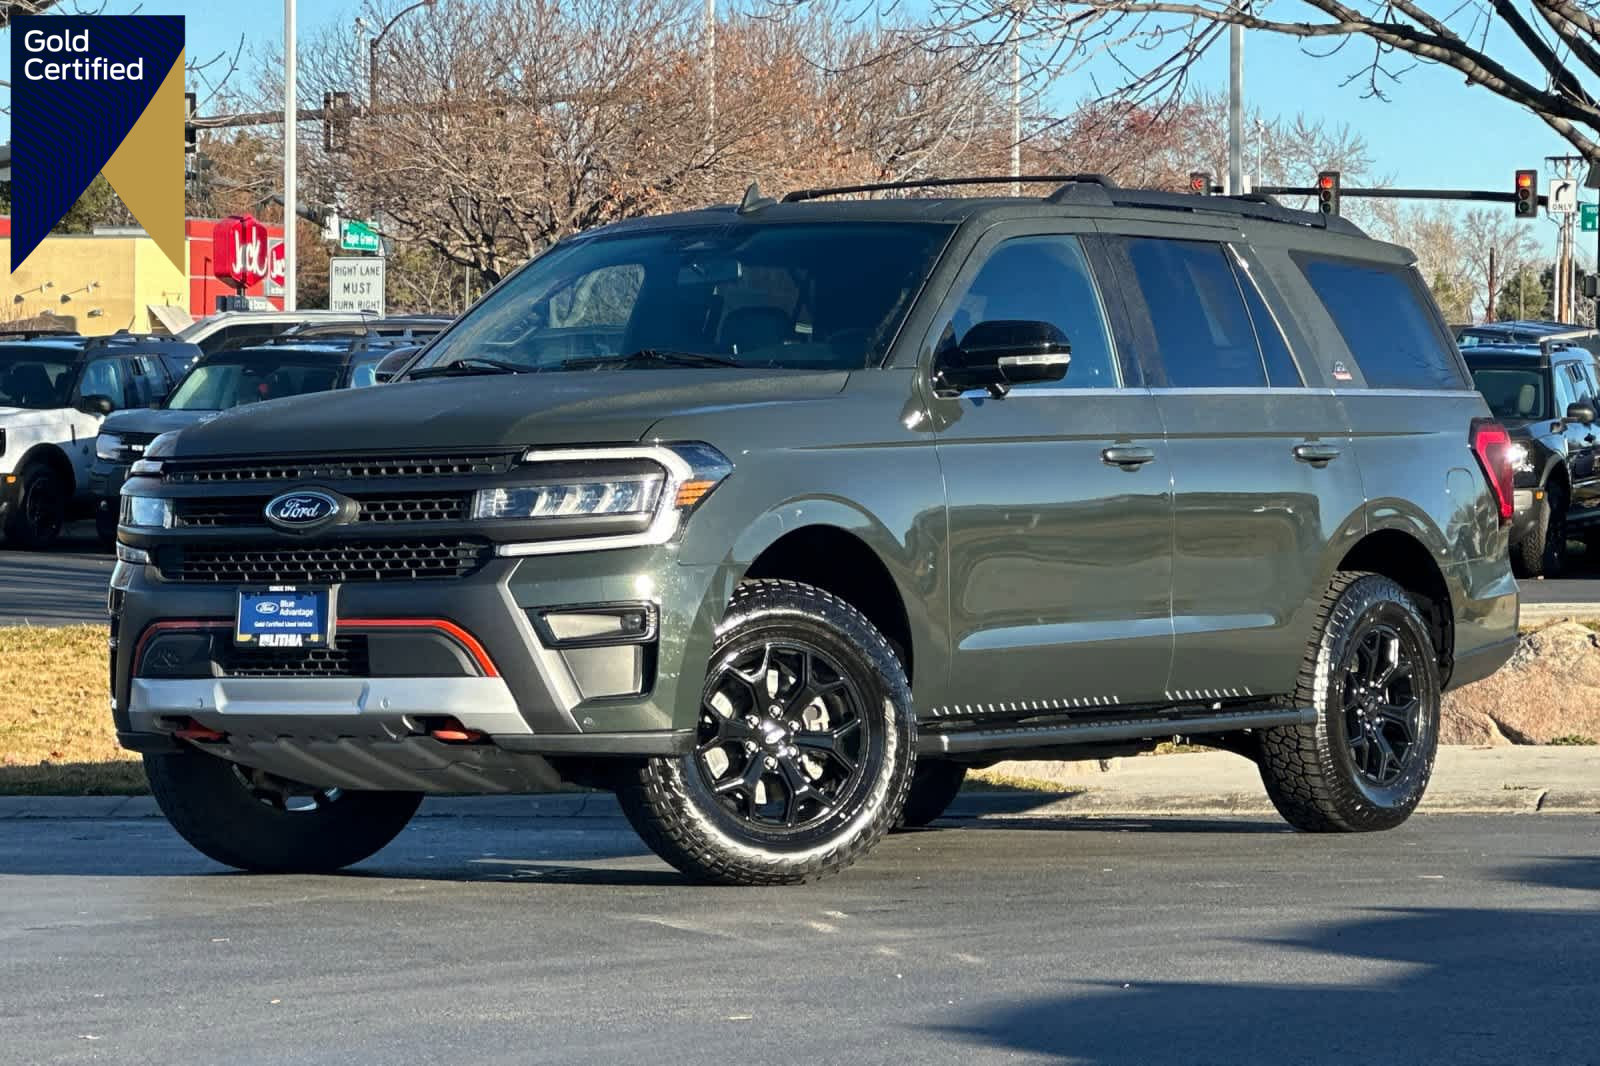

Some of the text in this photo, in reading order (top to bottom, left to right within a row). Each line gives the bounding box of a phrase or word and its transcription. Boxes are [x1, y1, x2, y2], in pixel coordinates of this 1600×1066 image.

[232, 226, 268, 276] Jack
[334, 266, 380, 276] RIGHT LANE
[343, 282, 371, 294] MUST
[334, 301, 380, 310] TURN RIGHT
[280, 498, 320, 518] Ford
[259, 603, 275, 612] Ford
[280, 600, 295, 608] Blue
[279, 608, 314, 617] Advantage
